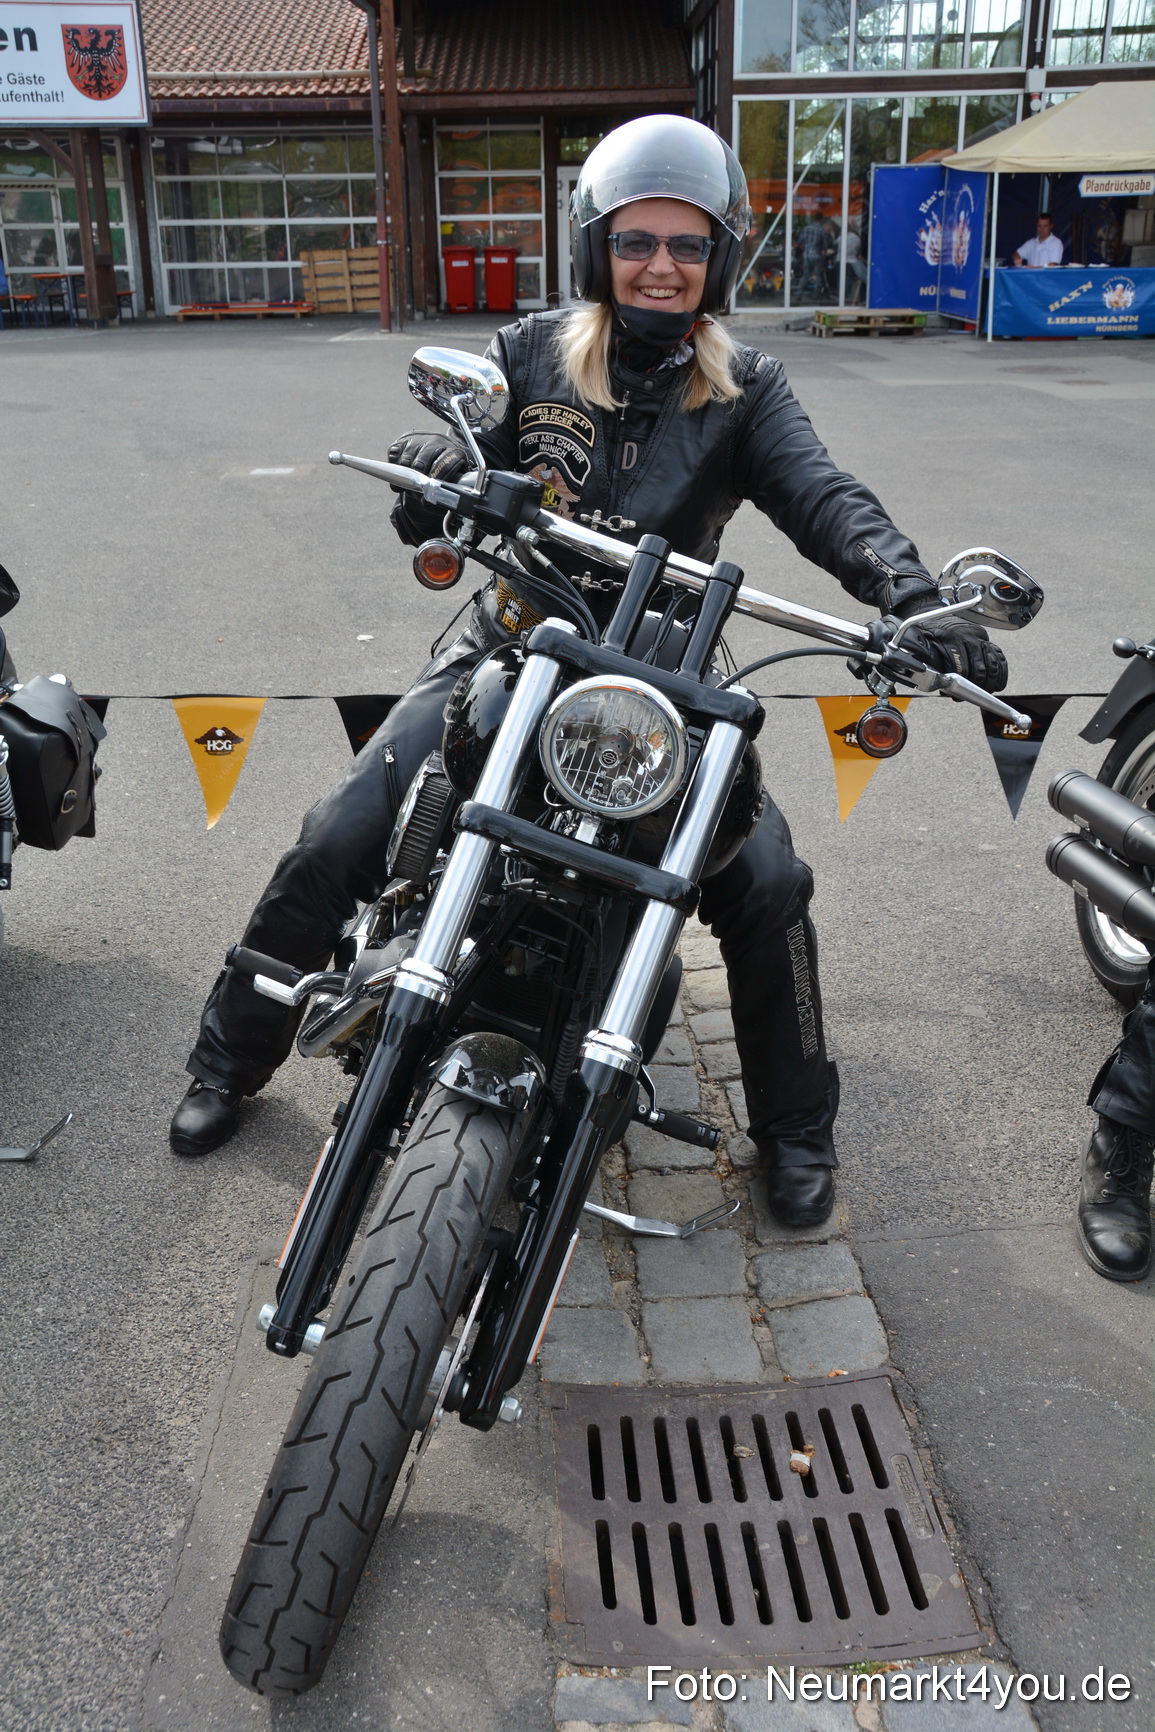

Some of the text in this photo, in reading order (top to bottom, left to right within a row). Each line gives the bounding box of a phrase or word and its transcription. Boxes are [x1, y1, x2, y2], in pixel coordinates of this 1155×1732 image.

[7, 72, 45, 85] Gäste
[0, 90, 65, 103] ufenthalt!
[1085, 179, 1151, 193] Pfandrückgabe
[1047, 315, 1139, 325] LIEBERMANN
[523, 407, 549, 419] LADIES
[562, 410, 591, 430] HARLEY
[539, 414, 573, 427] OFFICER
[523, 434, 585, 464] HERZ ASS CHAPTER
[538, 443, 568, 459] MUNICH
[206, 739, 232, 751] HOG
